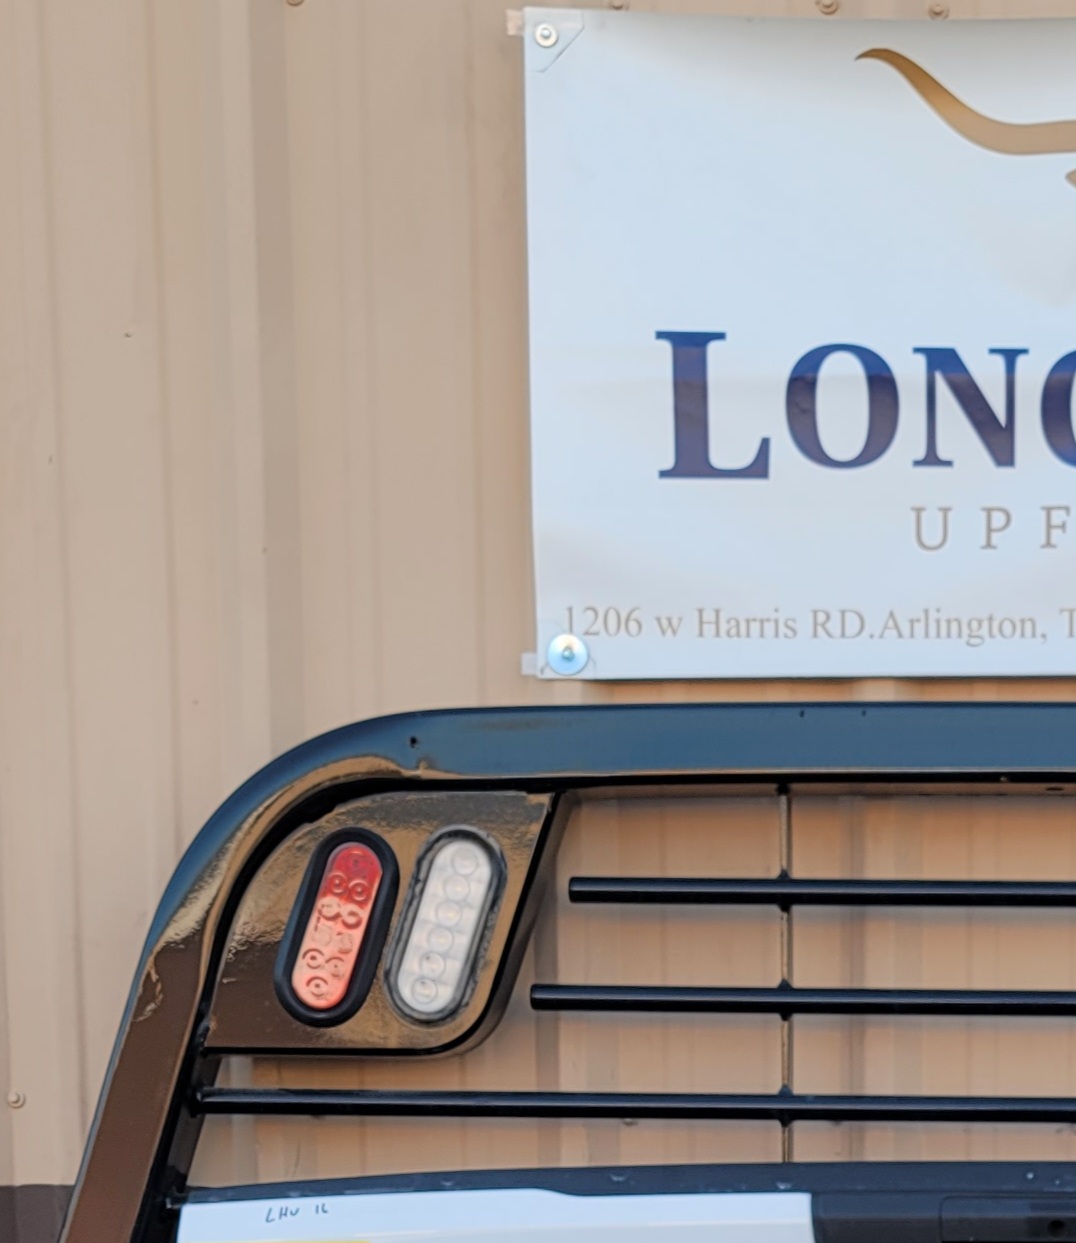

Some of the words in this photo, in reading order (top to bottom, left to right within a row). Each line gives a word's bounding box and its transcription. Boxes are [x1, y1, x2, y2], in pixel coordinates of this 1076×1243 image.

[564, 605, 643, 638] 1206
[655, 614, 684, 637] w
[695, 607, 798, 639] Harris
